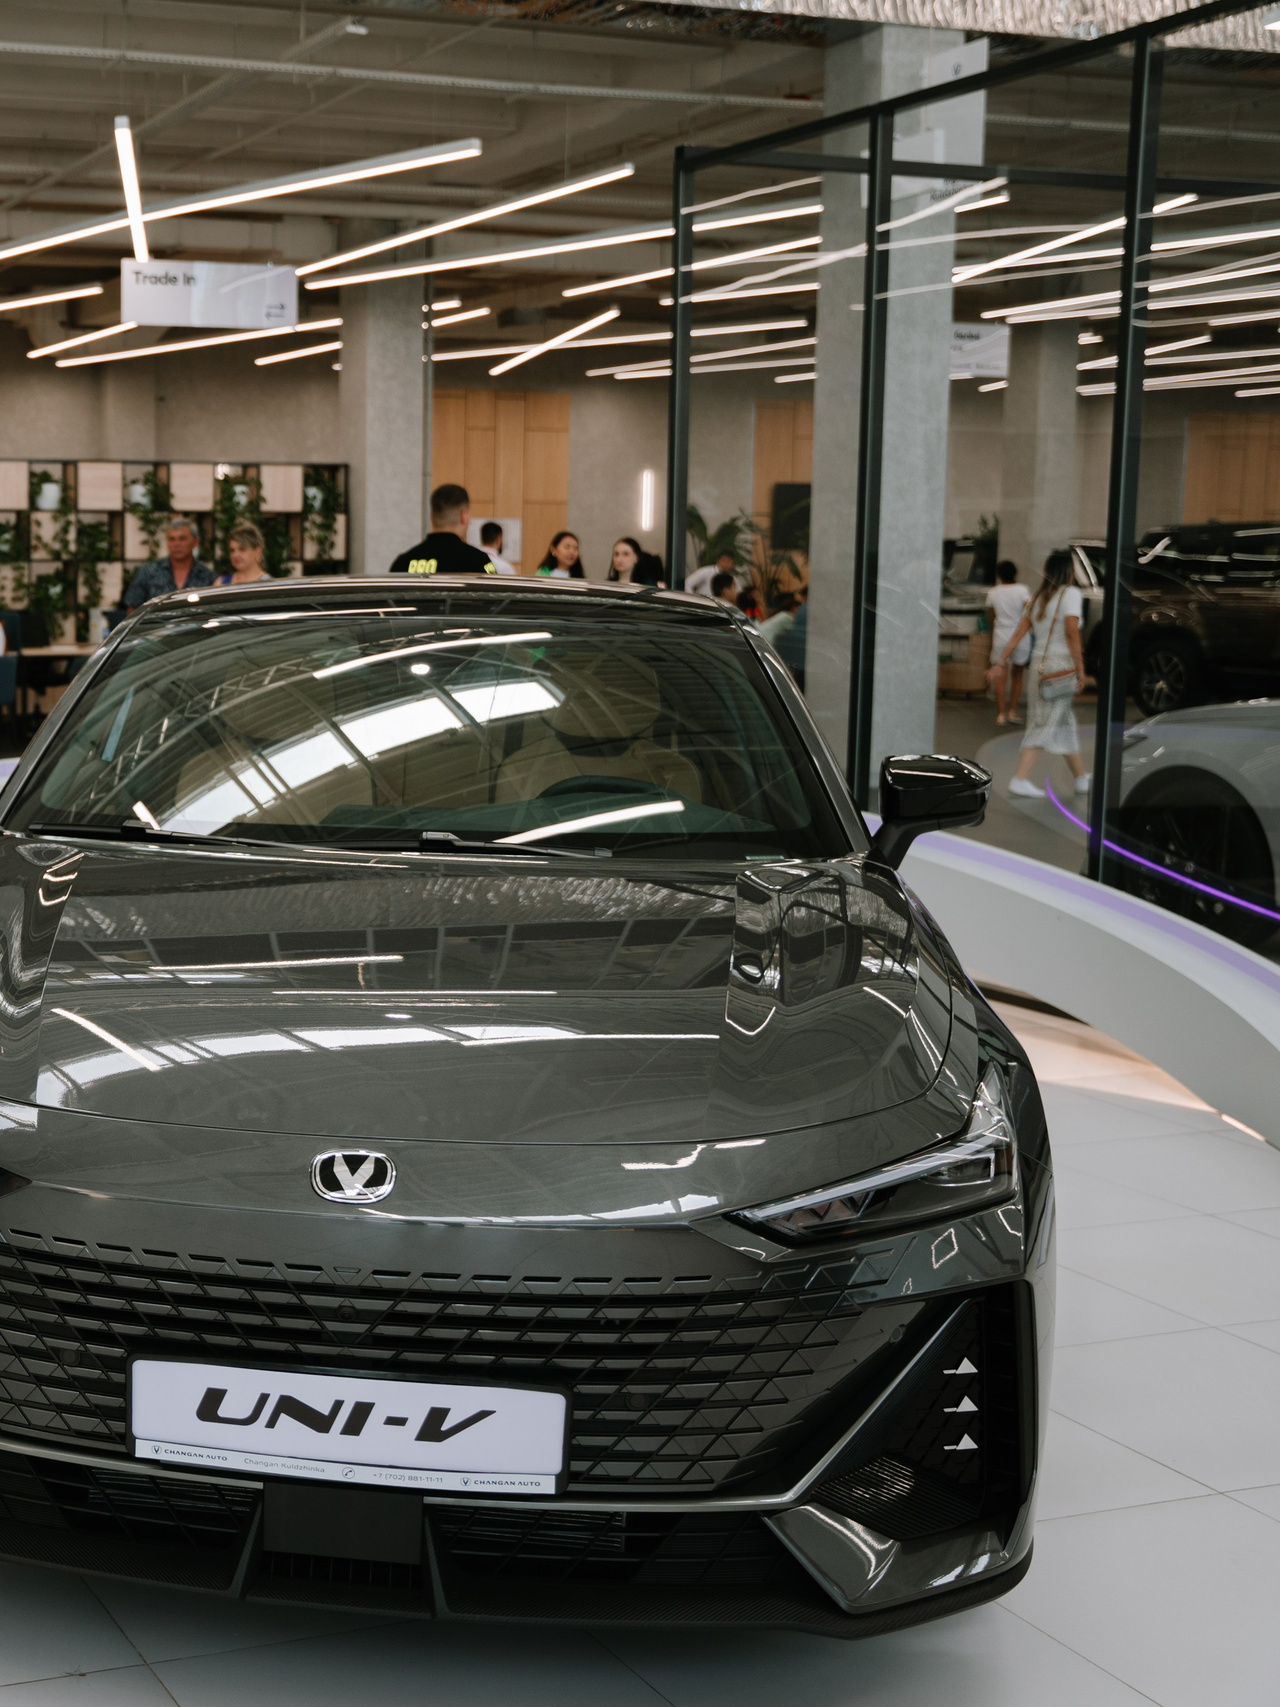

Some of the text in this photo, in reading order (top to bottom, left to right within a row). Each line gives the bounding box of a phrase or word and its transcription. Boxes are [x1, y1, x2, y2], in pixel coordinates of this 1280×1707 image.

[133, 271, 196, 287] Trade In
[195, 1386, 497, 1443] UNI-V
[164, 1448, 204, 1459] CHANGAN
[243, 1457, 279, 1468] Changan
